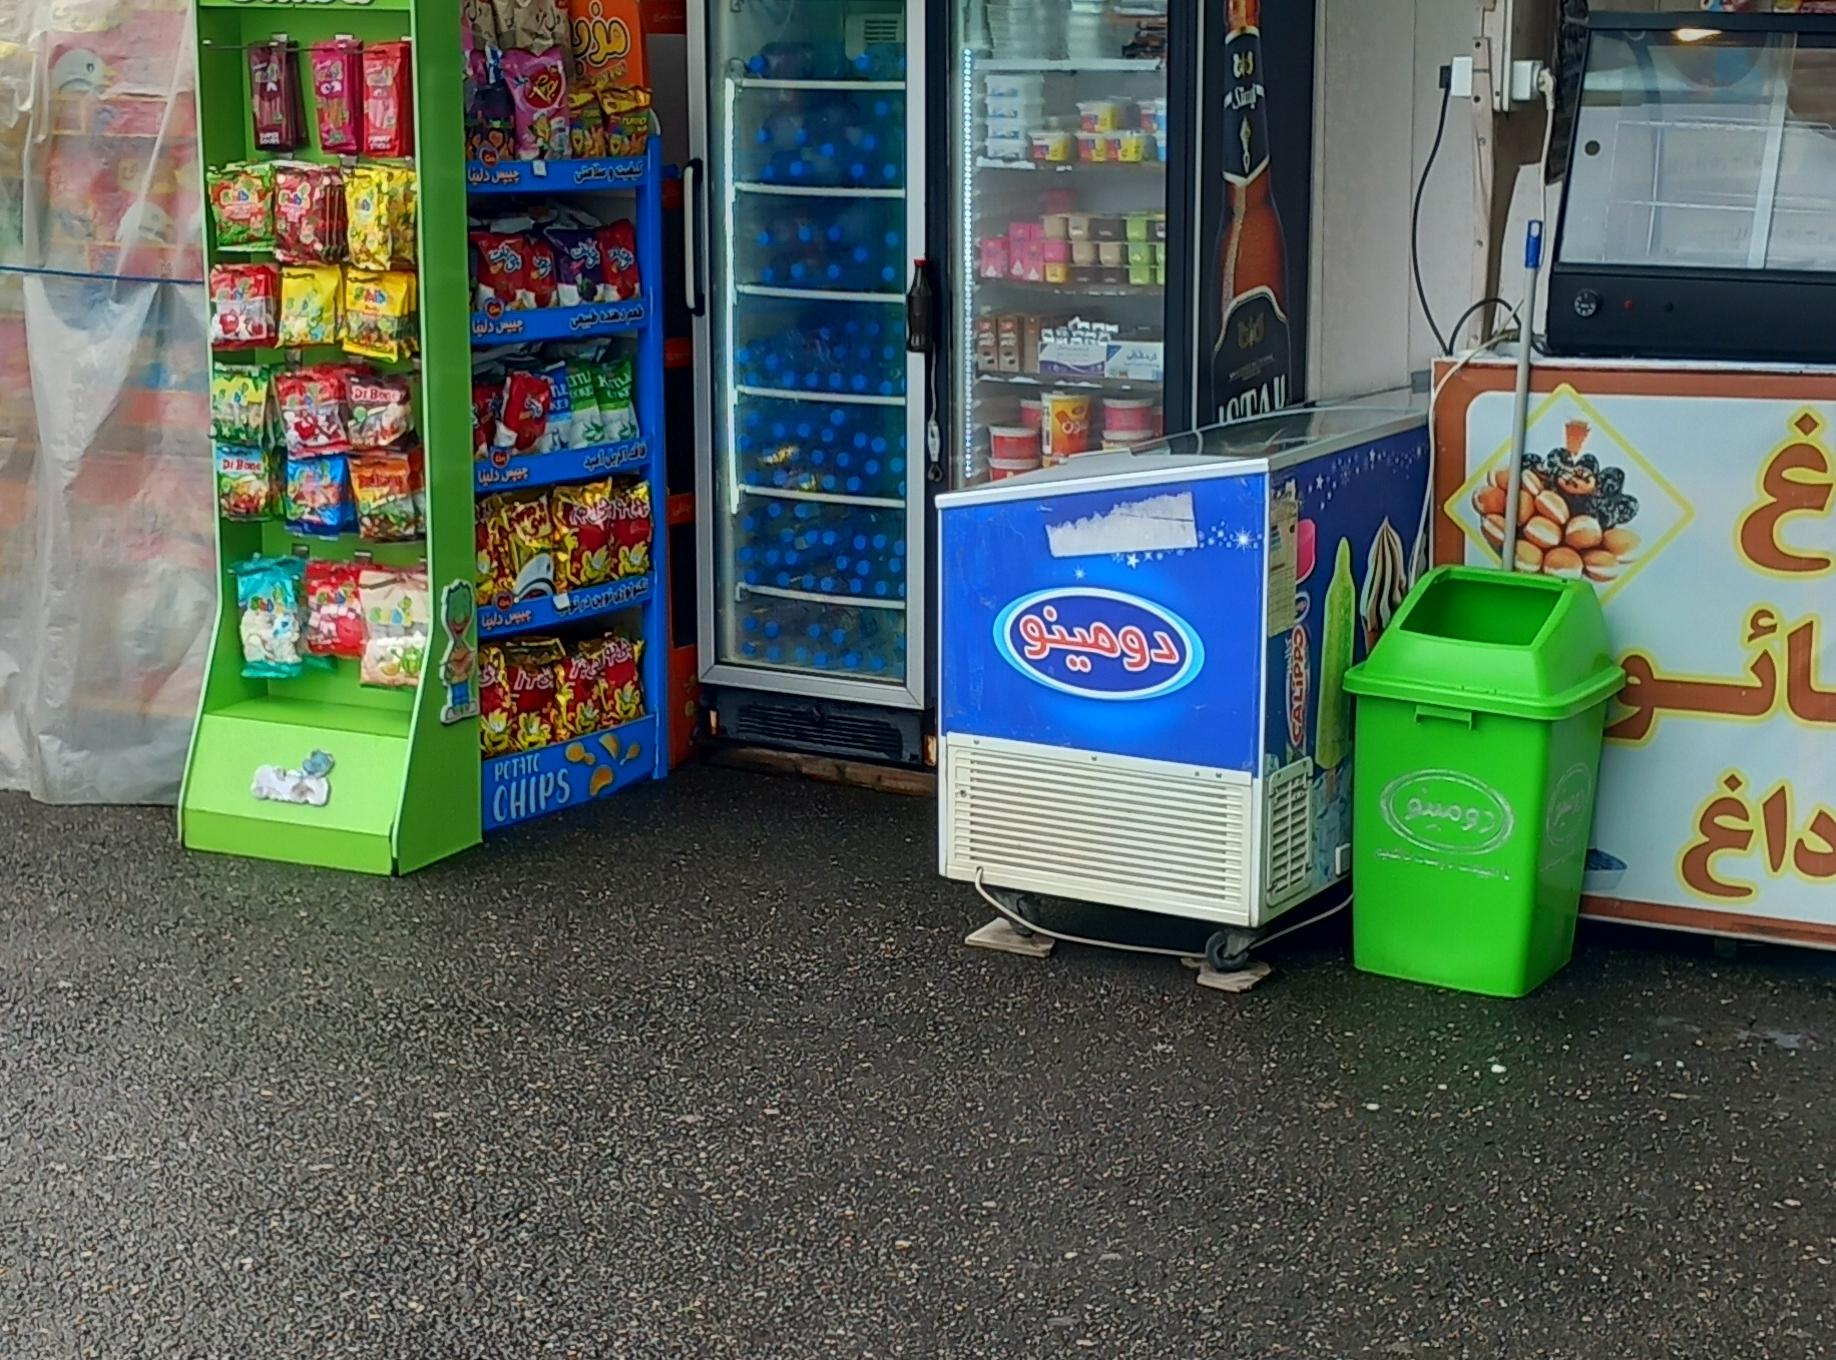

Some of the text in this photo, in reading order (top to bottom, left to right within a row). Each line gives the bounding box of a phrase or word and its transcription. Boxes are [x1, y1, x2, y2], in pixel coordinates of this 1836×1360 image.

[491, 169, 520, 185] چیپس
[496, 317, 524, 334] چیپس
[501, 465, 529, 481] چیپس
[504, 606, 533, 624] چیپس
[1016, 603, 1182, 674] دومینو
[494, 752, 541, 782] POTATO
[493, 768, 571, 822] CHIPS
